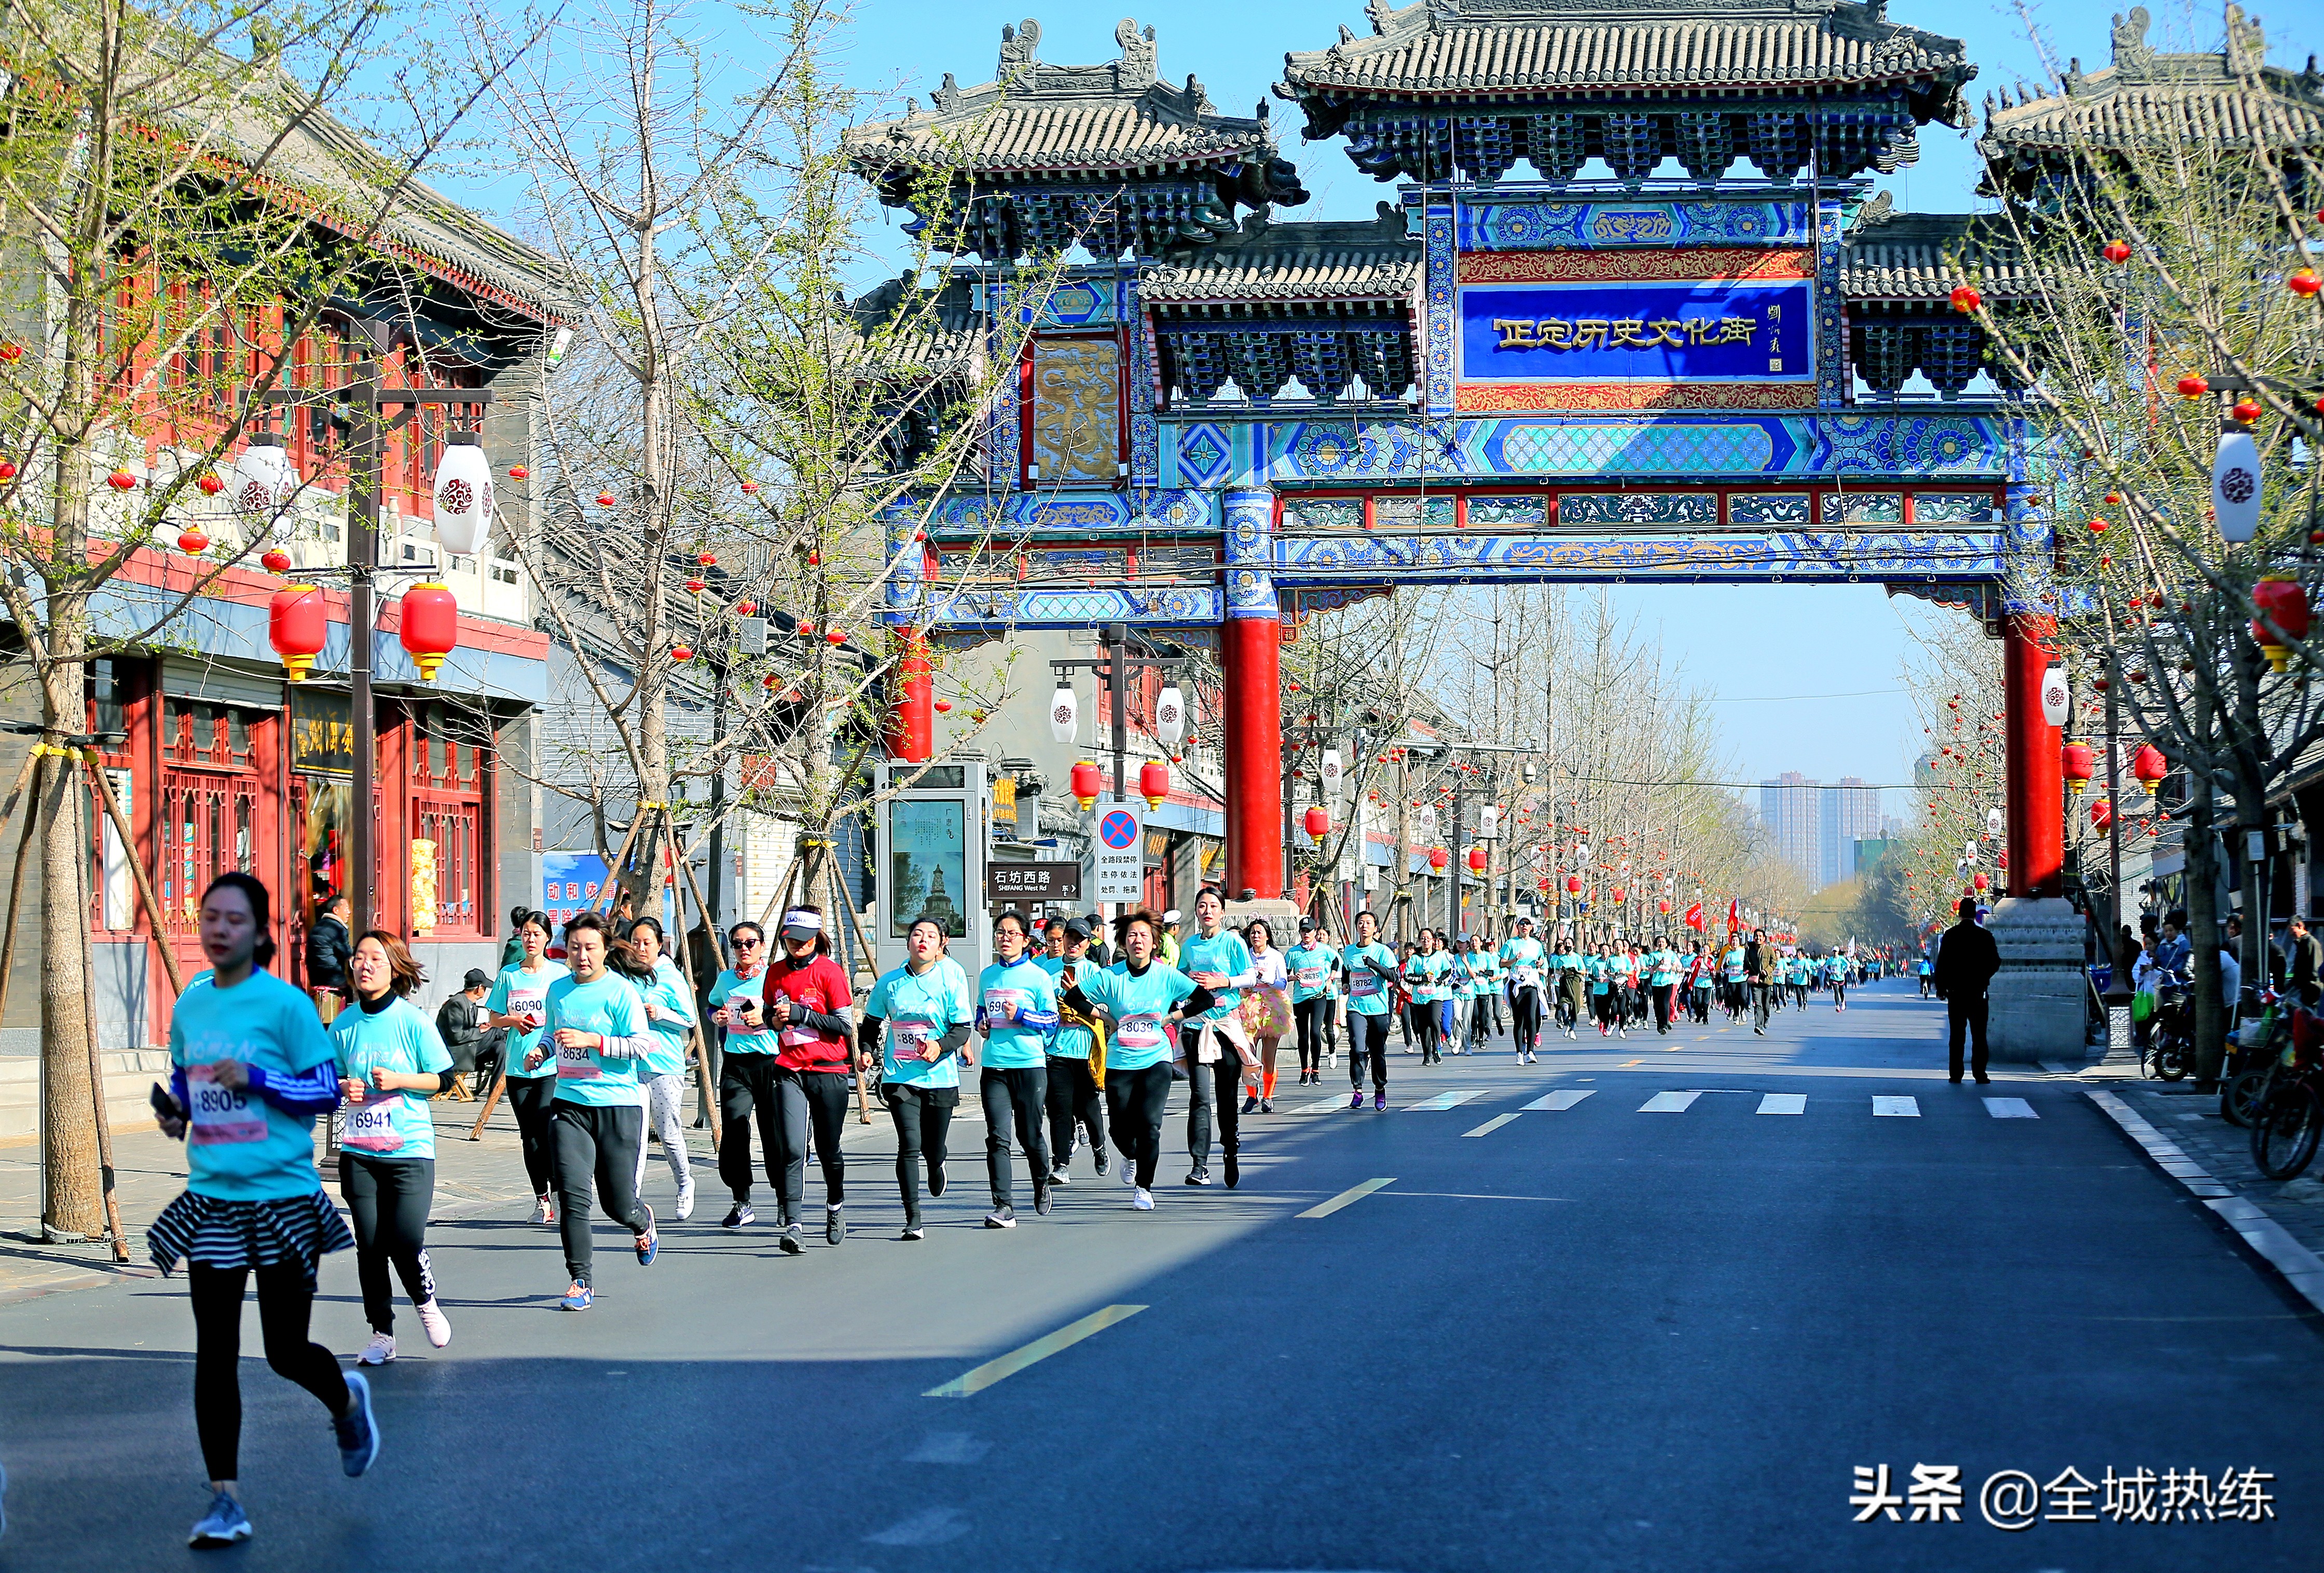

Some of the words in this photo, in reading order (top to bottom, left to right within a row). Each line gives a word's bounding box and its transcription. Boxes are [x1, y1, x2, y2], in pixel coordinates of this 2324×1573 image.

[1500, 317, 1757, 349] 正定历史文化街
[1285, 631, 1294, 640] 福
[995, 871, 1050, 884] 石坊西路
[515, 1000, 542, 1011] 6090
[1126, 1022, 1153, 1033] 8039
[563, 1047, 589, 1060] 8634
[200, 1090, 247, 1112] 8905
[356, 1112, 391, 1128] 6941
